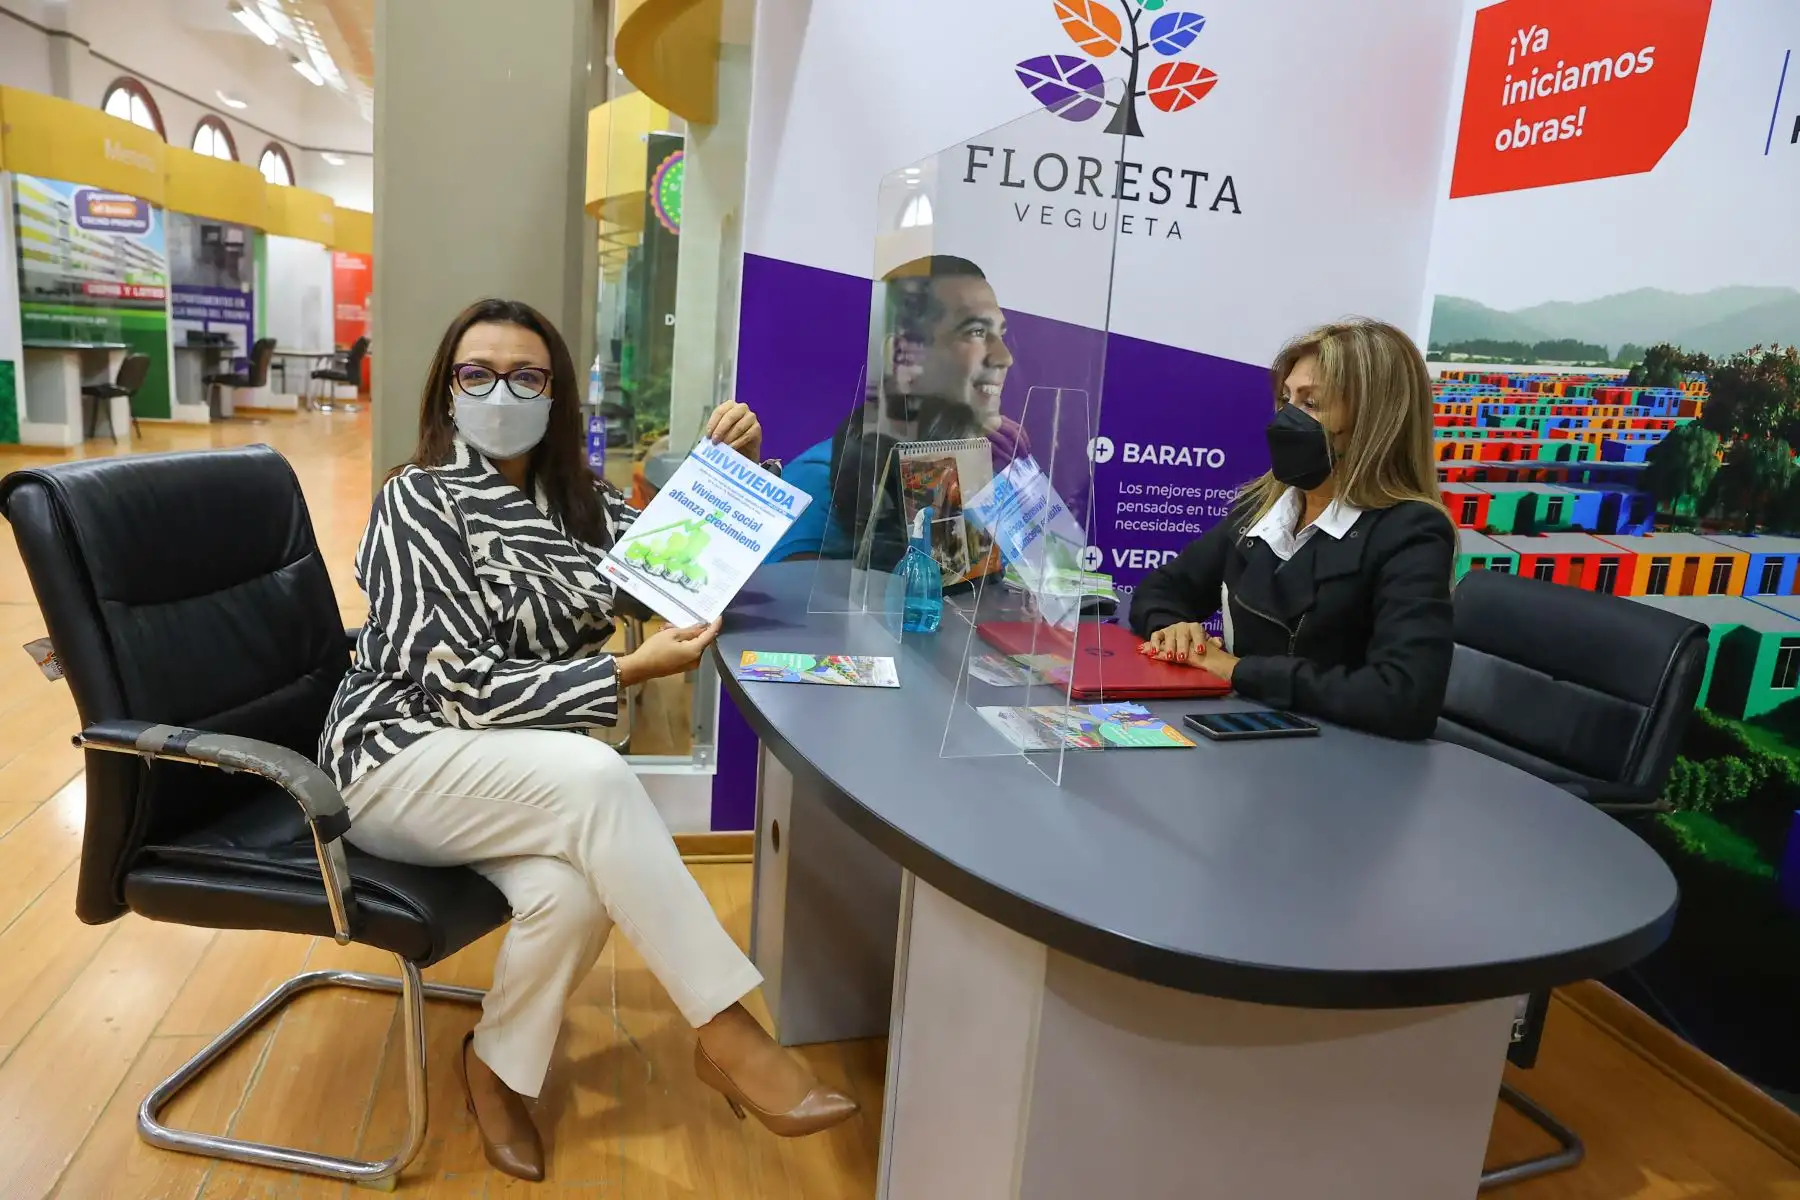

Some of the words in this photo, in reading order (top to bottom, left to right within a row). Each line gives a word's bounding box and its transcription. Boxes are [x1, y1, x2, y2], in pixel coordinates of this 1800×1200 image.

[1507, 24, 1549, 66] ¡Ya
[1501, 45, 1656, 106] iniciamos
[1495, 106, 1587, 152] obras!
[963, 144, 1242, 215] FLORESTA
[1014, 202, 1182, 240] VEGUETA
[1122, 442, 1226, 469] BARATO
[701, 445, 795, 511] MIVIVIENDA
[1119, 481, 1143, 494] Los
[1146, 484, 1201, 500] mejores
[668, 487, 706, 518] afianza
[704, 512, 761, 553] crecimiento
[691, 480, 733, 514] Vivienda
[731, 509, 763, 533] social
[1115, 519, 1203, 534] necesidades.
[1116, 500, 1183, 515] pensados
[1186, 506, 1204, 516] en
[1207, 505, 1229, 517] tus
